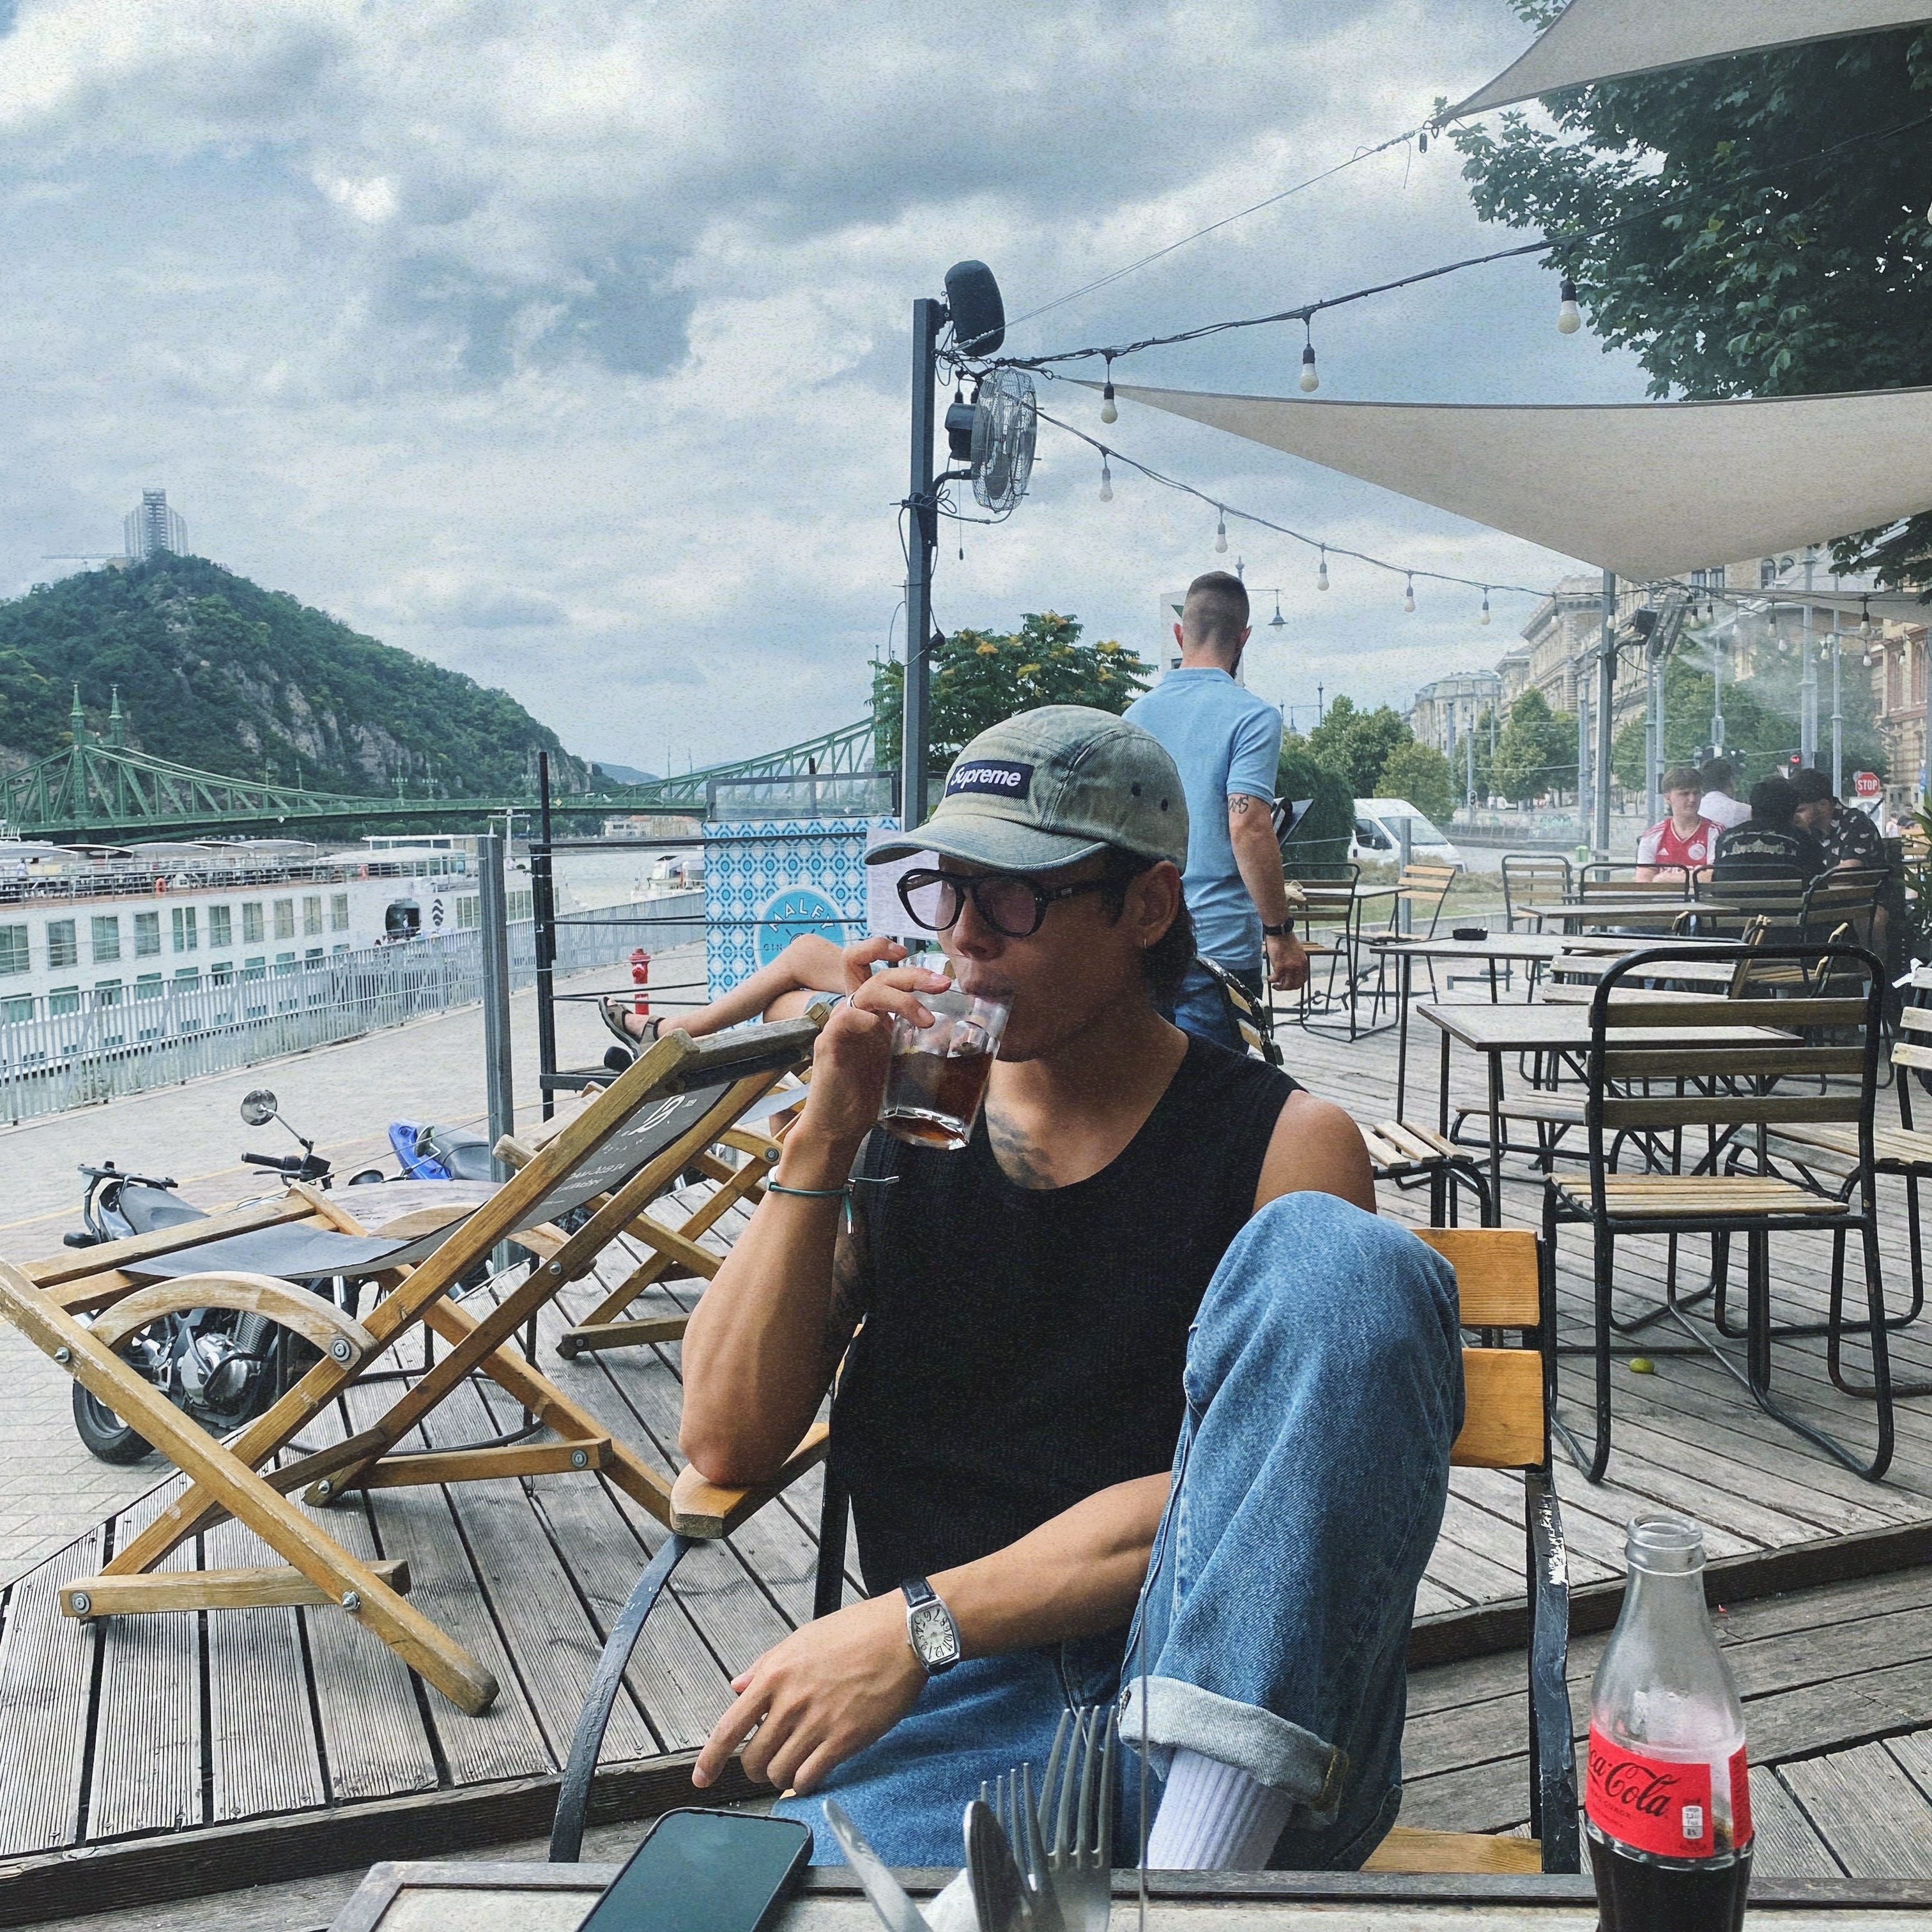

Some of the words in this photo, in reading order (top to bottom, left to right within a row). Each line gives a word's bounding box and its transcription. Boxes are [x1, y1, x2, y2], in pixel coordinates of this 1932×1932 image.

[950, 766, 1022, 789] Supreme
[1857, 779, 1878, 791] STOP
[768, 898, 836, 933] MALFY
[1588, 1749, 1682, 1817] ca-Cola
